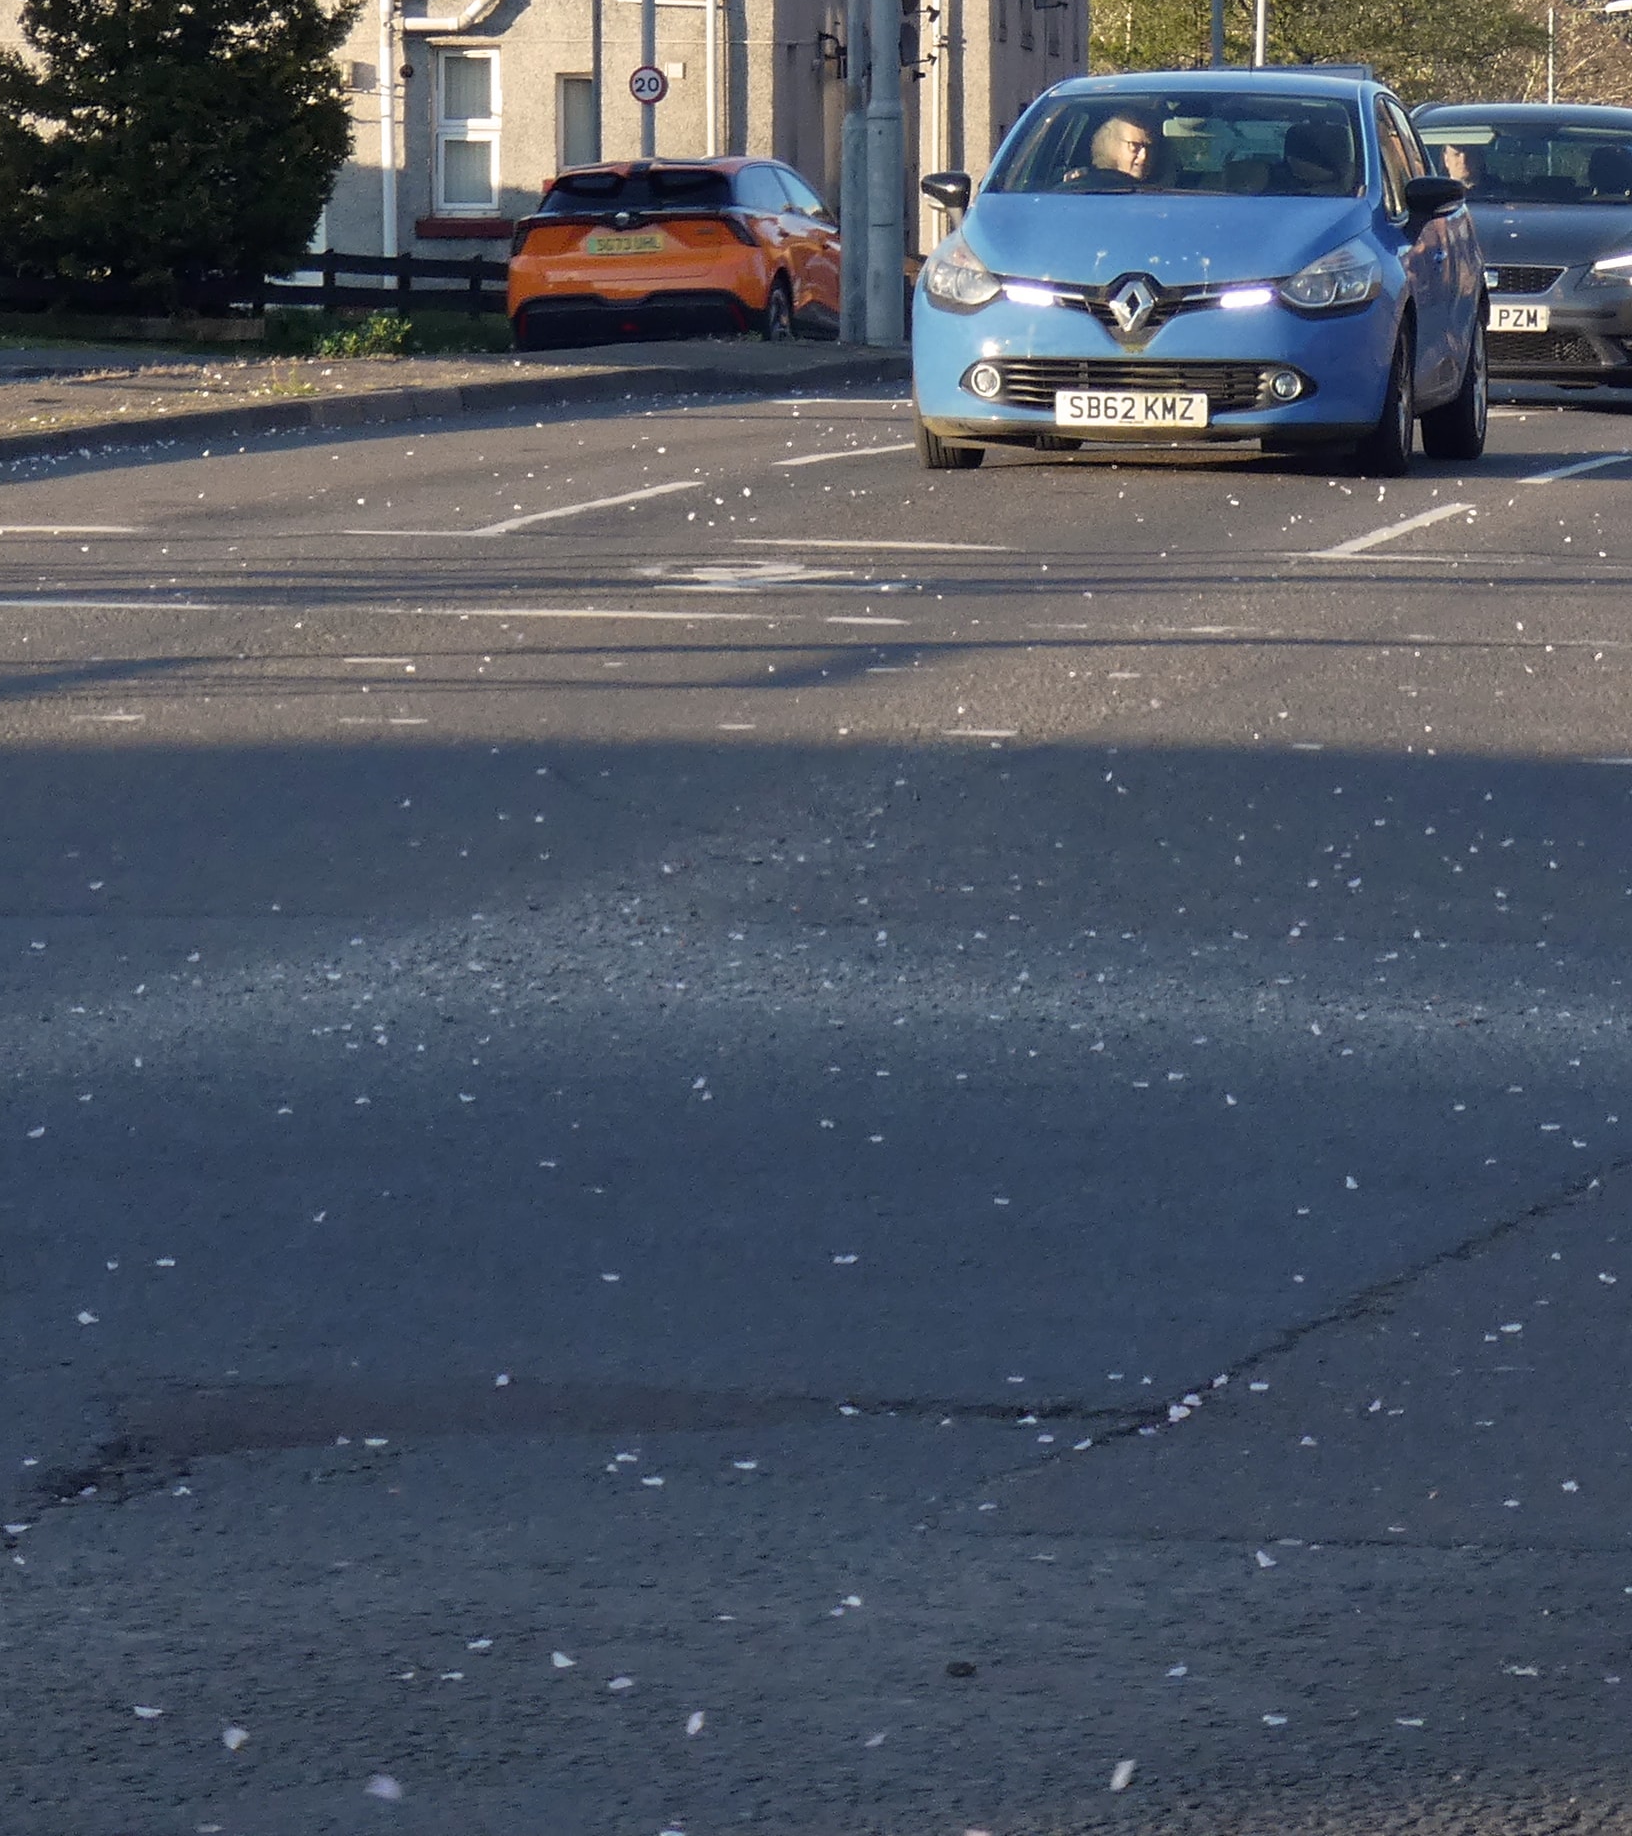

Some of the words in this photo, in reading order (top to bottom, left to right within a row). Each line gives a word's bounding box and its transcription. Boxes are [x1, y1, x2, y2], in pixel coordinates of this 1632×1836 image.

[634, 76, 660, 93] 20
[1498, 308, 1538, 328] PZM
[1069, 395, 1136, 420] SB62
[1143, 396, 1195, 421] KMZ
